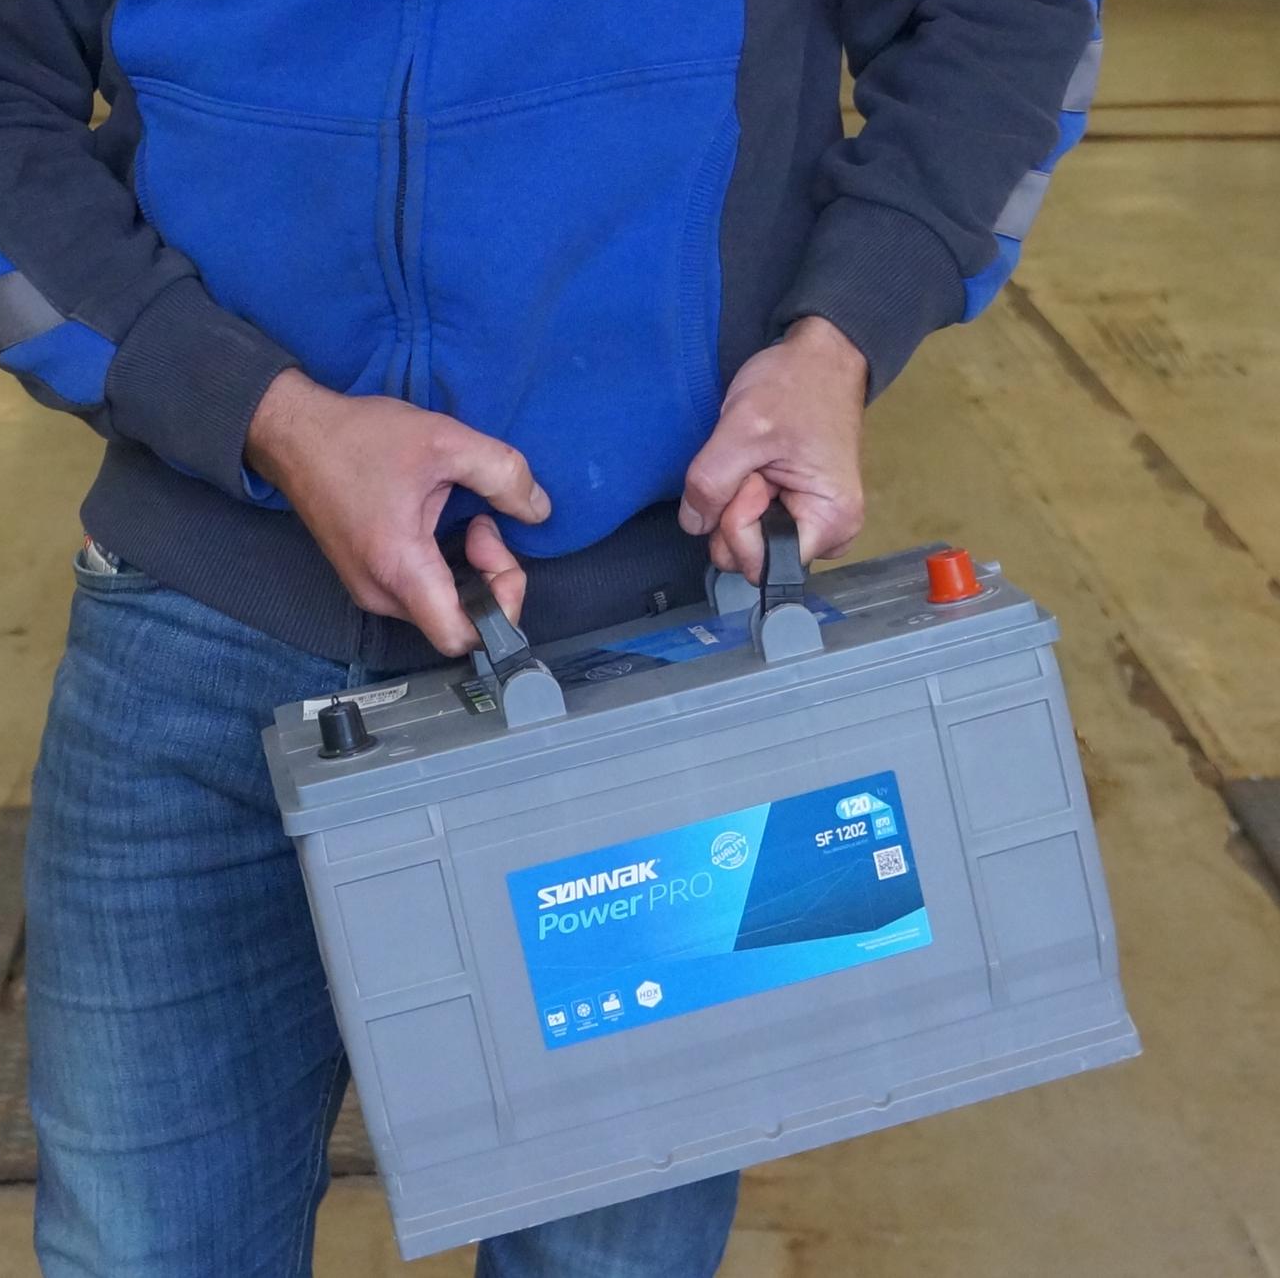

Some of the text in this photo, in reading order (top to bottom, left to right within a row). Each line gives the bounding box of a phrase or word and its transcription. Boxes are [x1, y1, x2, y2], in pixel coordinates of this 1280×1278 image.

[840, 796, 871, 818] 120
[815, 830, 834, 847] SF
[835, 821, 868, 841] 1202
[711, 835, 747, 866] QUALITY
[538, 872, 713, 941] Power PRO
